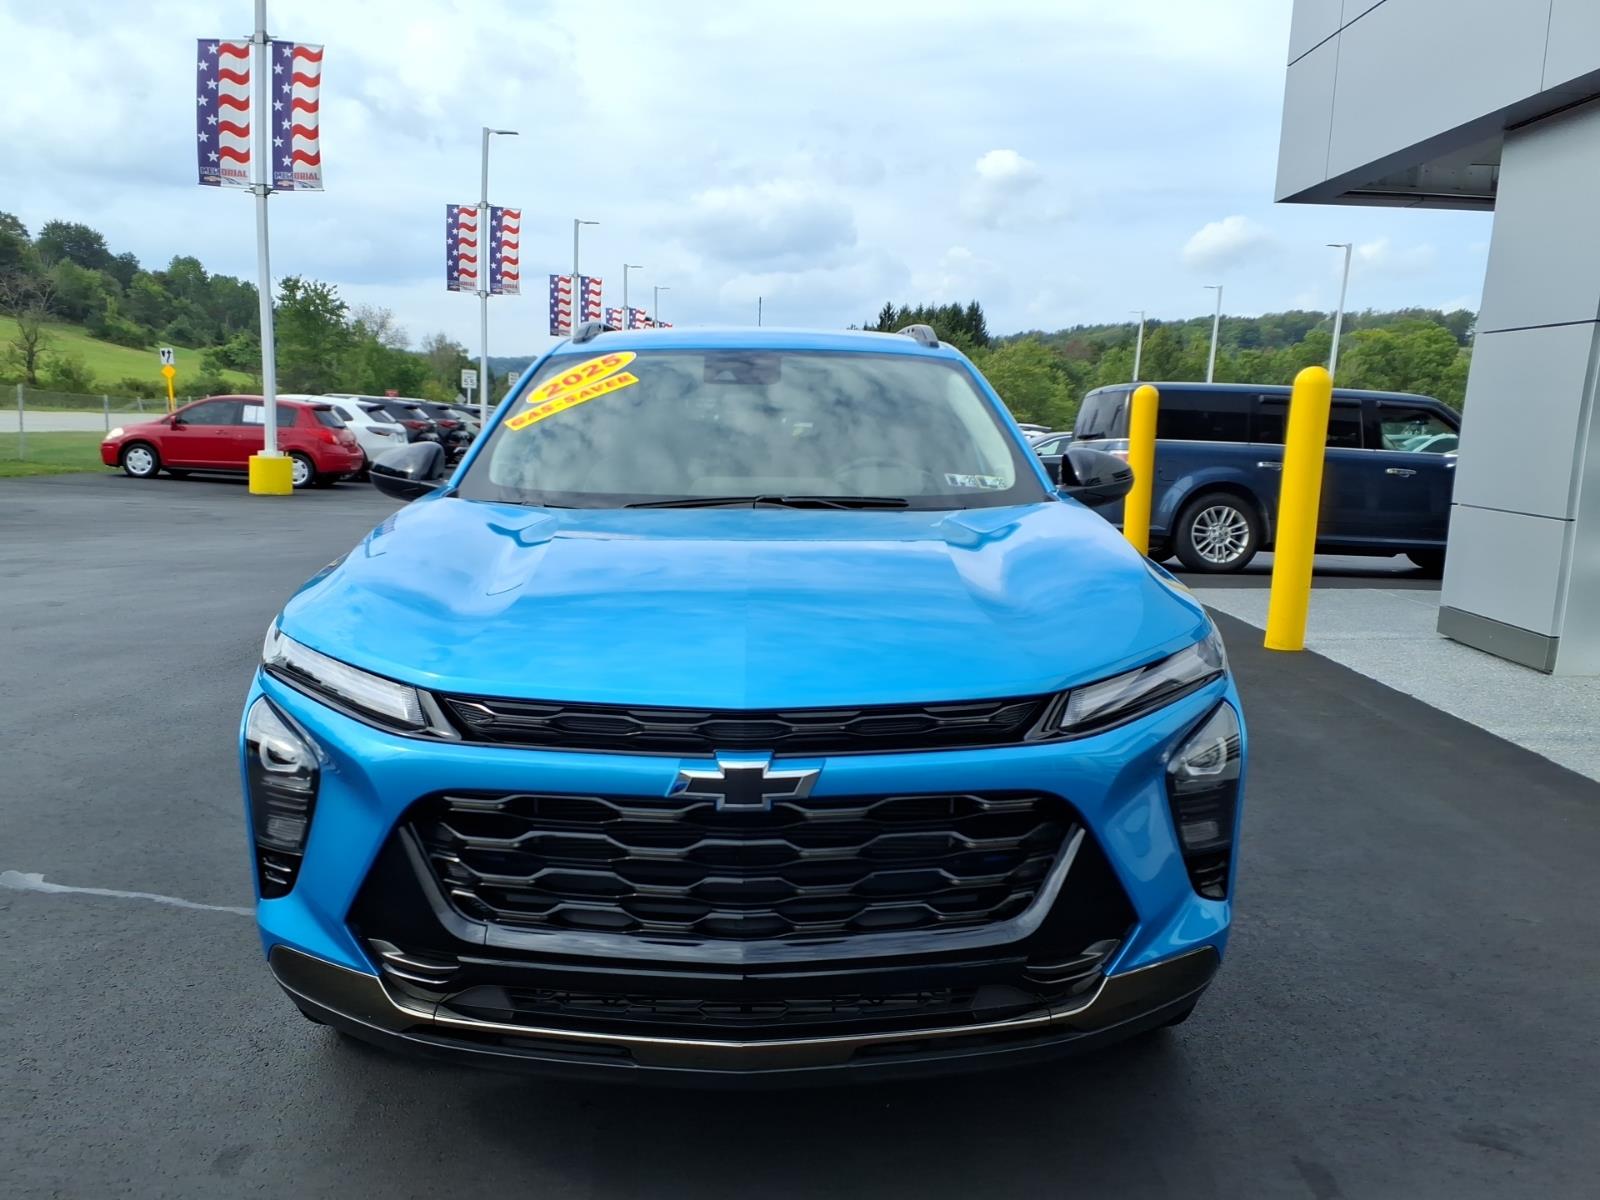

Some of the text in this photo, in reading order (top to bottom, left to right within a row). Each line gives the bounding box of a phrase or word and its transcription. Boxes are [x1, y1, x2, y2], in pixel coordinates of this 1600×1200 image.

[199, 166, 247, 178] MEMORIAL
[274, 171, 320, 181] MEMORIAL
[541, 355, 622, 397] 2025
[511, 374, 633, 427] GAS-SAVER
